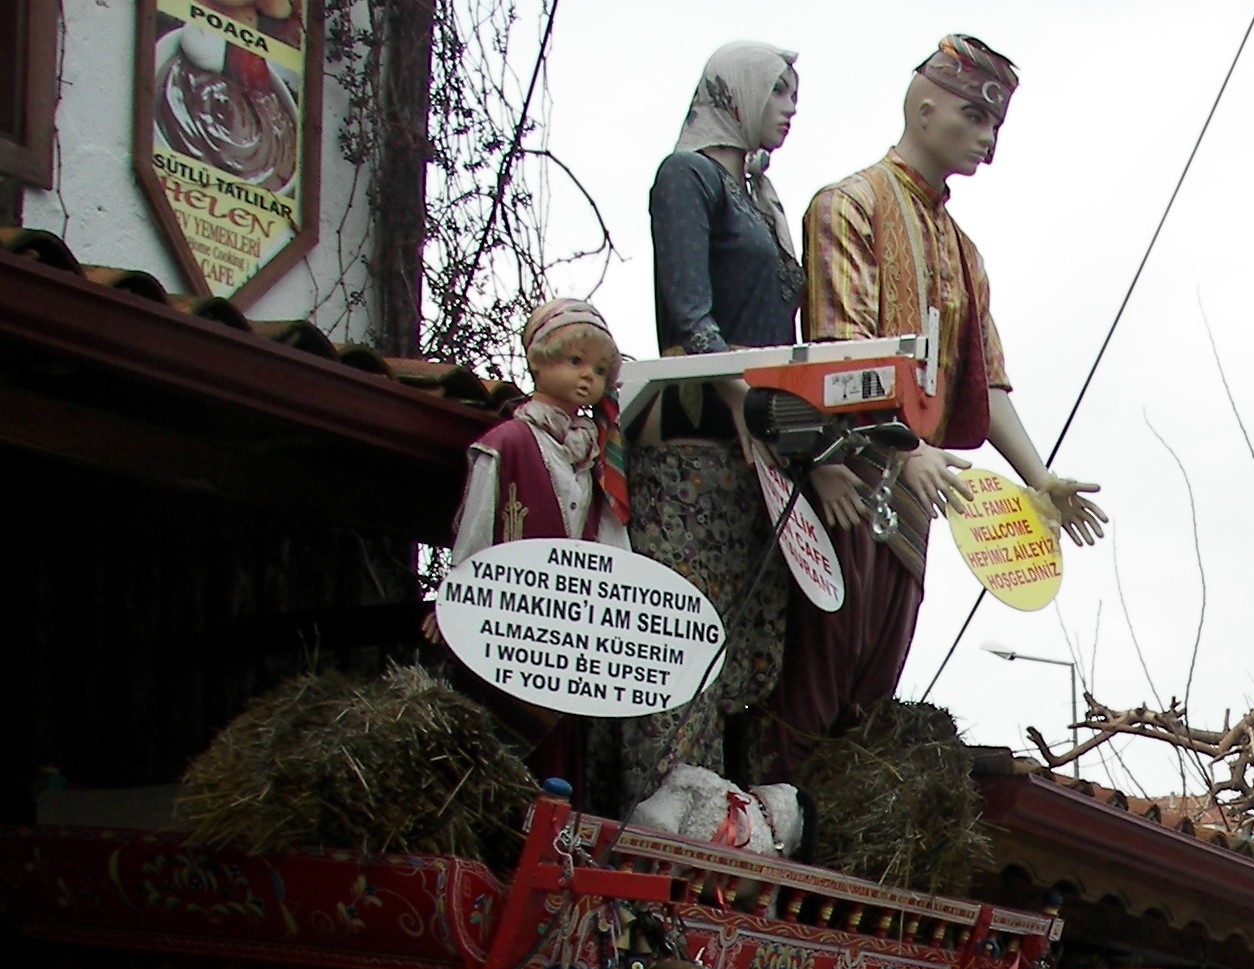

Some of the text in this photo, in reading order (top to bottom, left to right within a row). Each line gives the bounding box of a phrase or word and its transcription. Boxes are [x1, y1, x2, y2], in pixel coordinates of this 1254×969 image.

[190, 5, 269, 52] POAÇA
[153, 153, 292, 219] SÜTLÜ TATLILAR
[194, 214, 261, 258] YEMEKLERİ
[201, 257, 235, 287] CAFE
[979, 476, 1003, 493] ARE
[963, 496, 1023, 520] ALL FAMILY
[967, 535, 1056, 568] HEPİMİZ AİLEYİZ
[970, 519, 1033, 543] WELLCOME
[547, 547, 613, 574] ANNEM
[986, 559, 1061, 592] HOŞGELDİNİZ
[471, 560, 701, 614] YAPIYOR BEN SATIYORUM
[445, 582, 493, 608] MAM
[600, 607, 631, 630] AM
[637, 611, 719, 645] SELLING
[480, 619, 684, 665] ALMAZSAN KÜSERİM
[485, 642, 671, 686] I WOULD BE UPSET
[495, 668, 513, 684] IF
[519, 672, 560, 691] YOU
[614, 686, 626, 702] T
[632, 689, 672, 709] BUY
